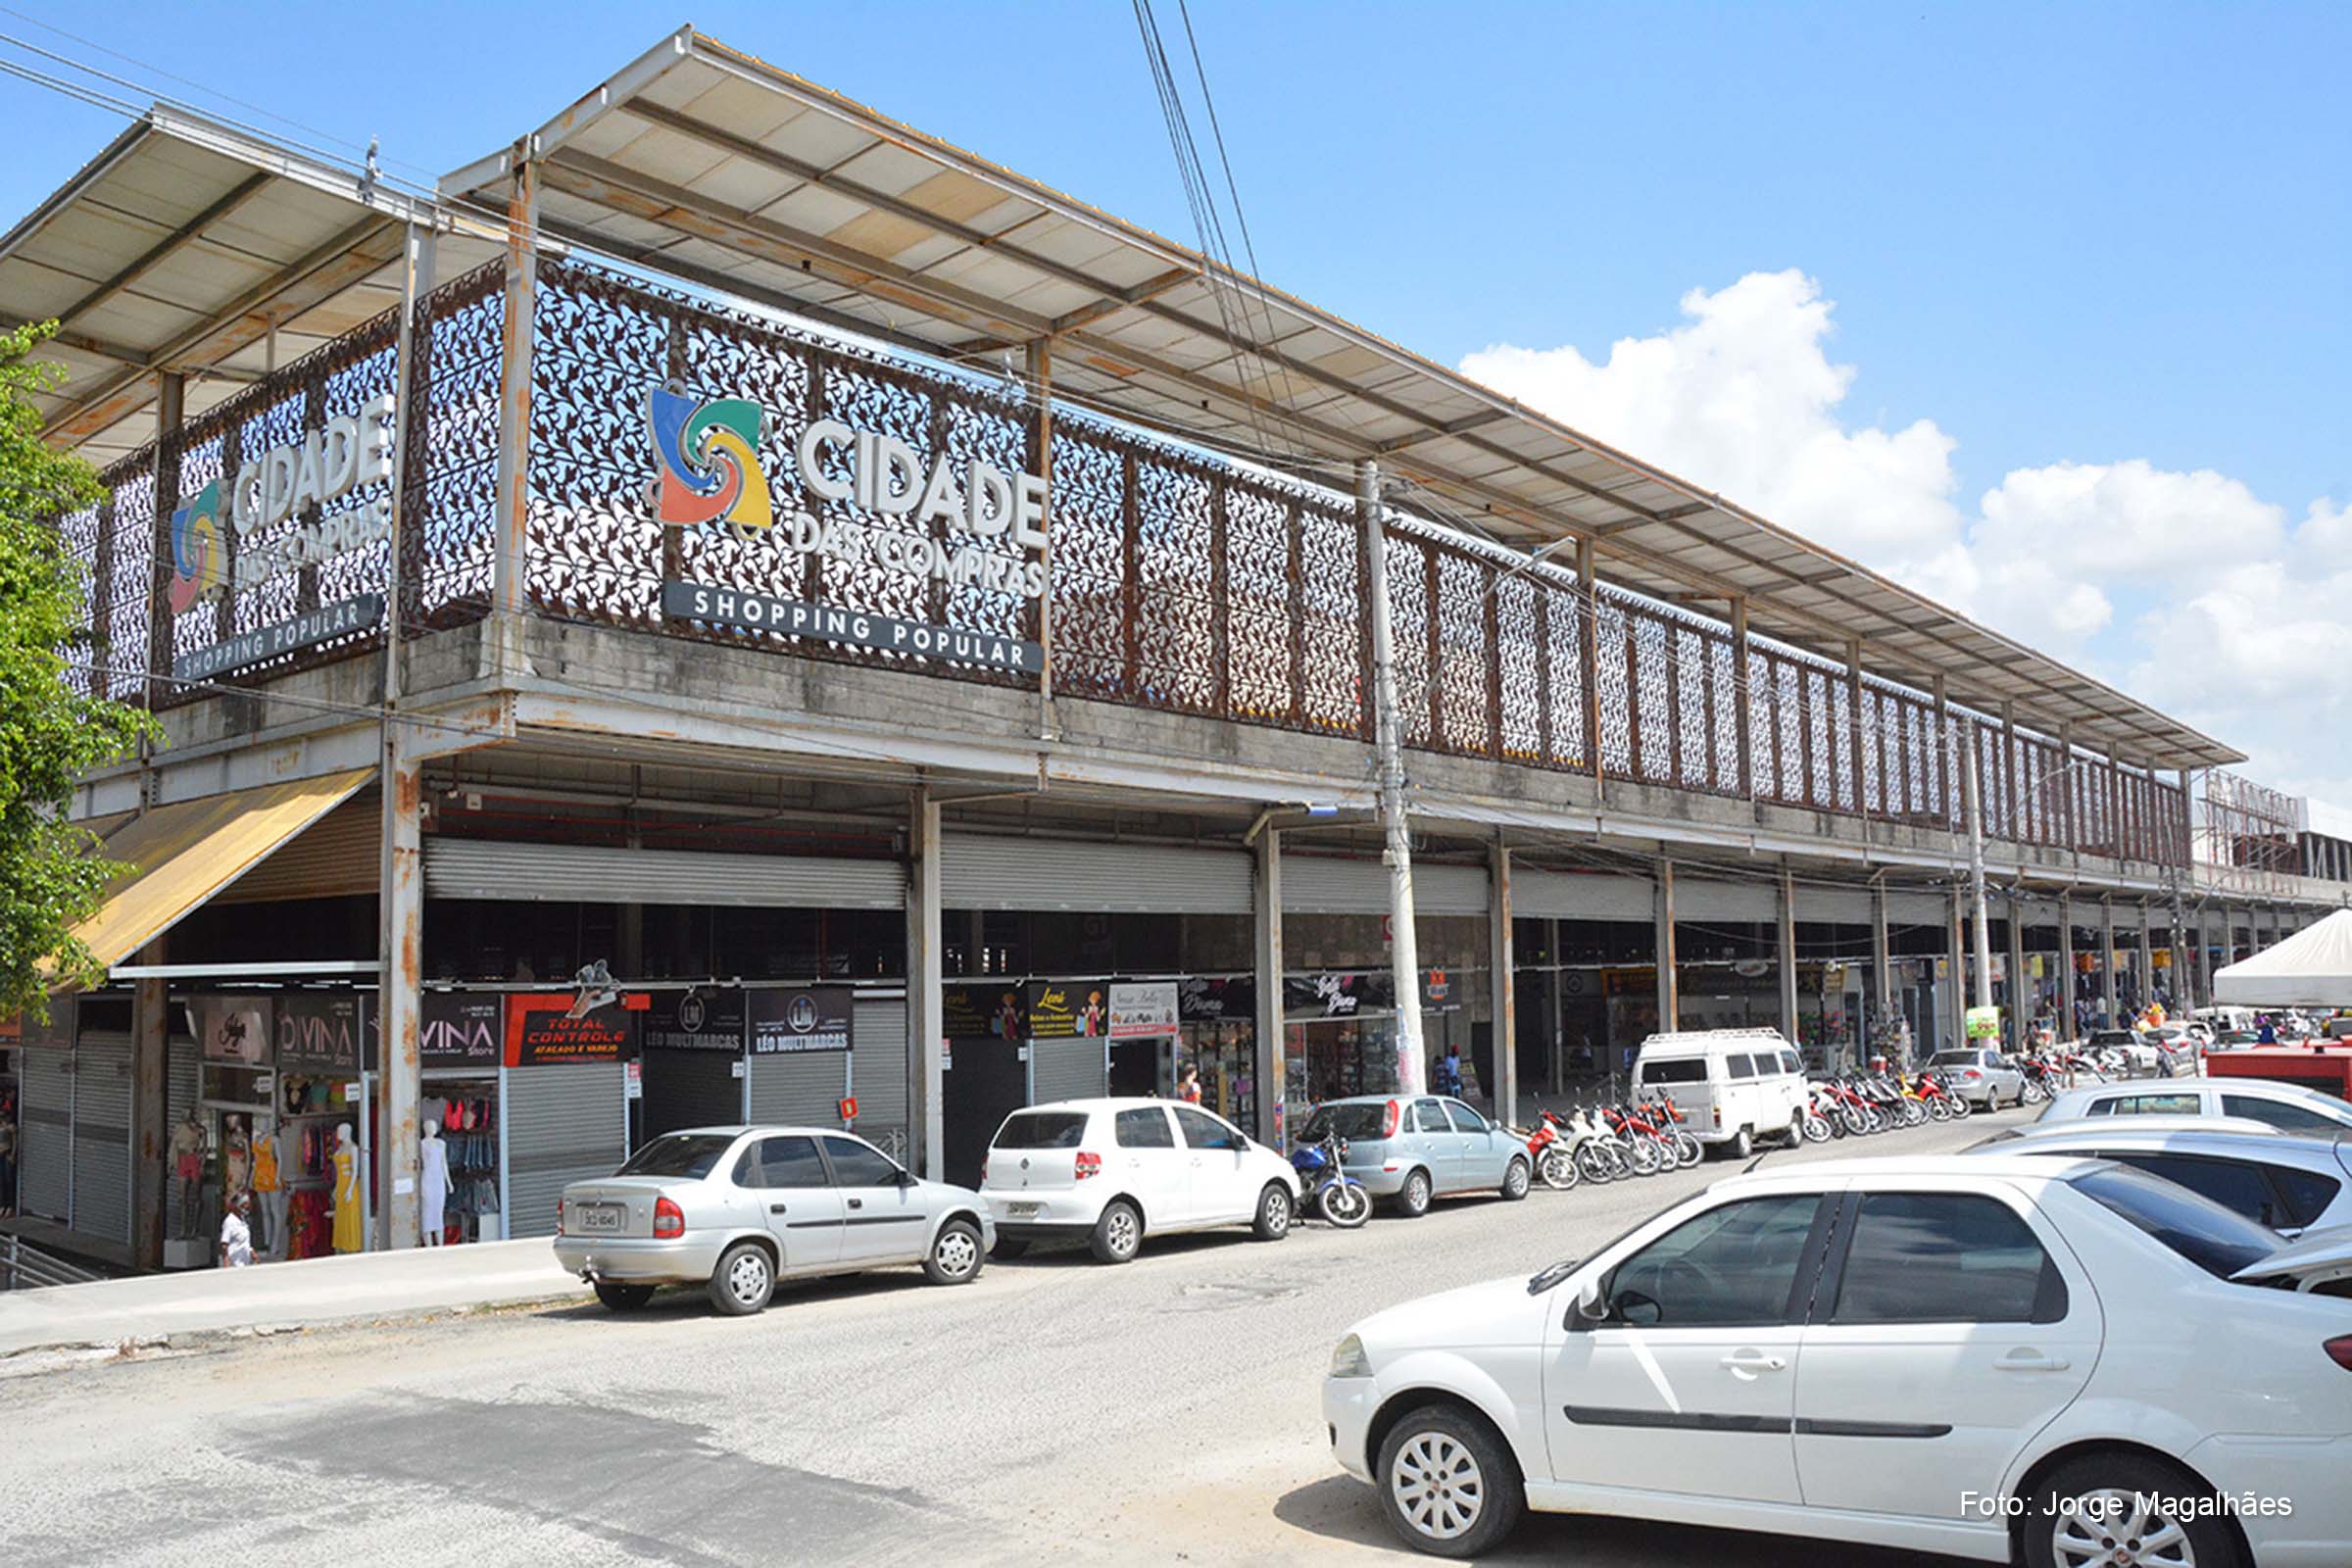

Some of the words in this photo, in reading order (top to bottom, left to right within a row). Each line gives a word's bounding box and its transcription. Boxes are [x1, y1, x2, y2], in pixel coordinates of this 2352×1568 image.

[232, 394, 393, 536] CIDADE
[798, 419, 1047, 549] CIDADE
[234, 551, 269, 588] DAS
[280, 497, 391, 571] COMPRAS
[791, 512, 862, 563] DAS
[882, 531, 1044, 599] COMPRAS
[183, 635, 264, 677] SHOPPING
[274, 604, 358, 650] POPULAR
[695, 590, 870, 639] SHOPPING
[894, 624, 1024, 666] POPULAR
[281, 1014, 353, 1054] DIVINA
[421, 1020, 495, 1049] VINA
[527, 1031, 625, 1044] CONTROLE
[548, 1018, 605, 1029] TOTAL
[757, 1034, 776, 1053] LÉO
[777, 1032, 849, 1051] MULTIMARCAS
